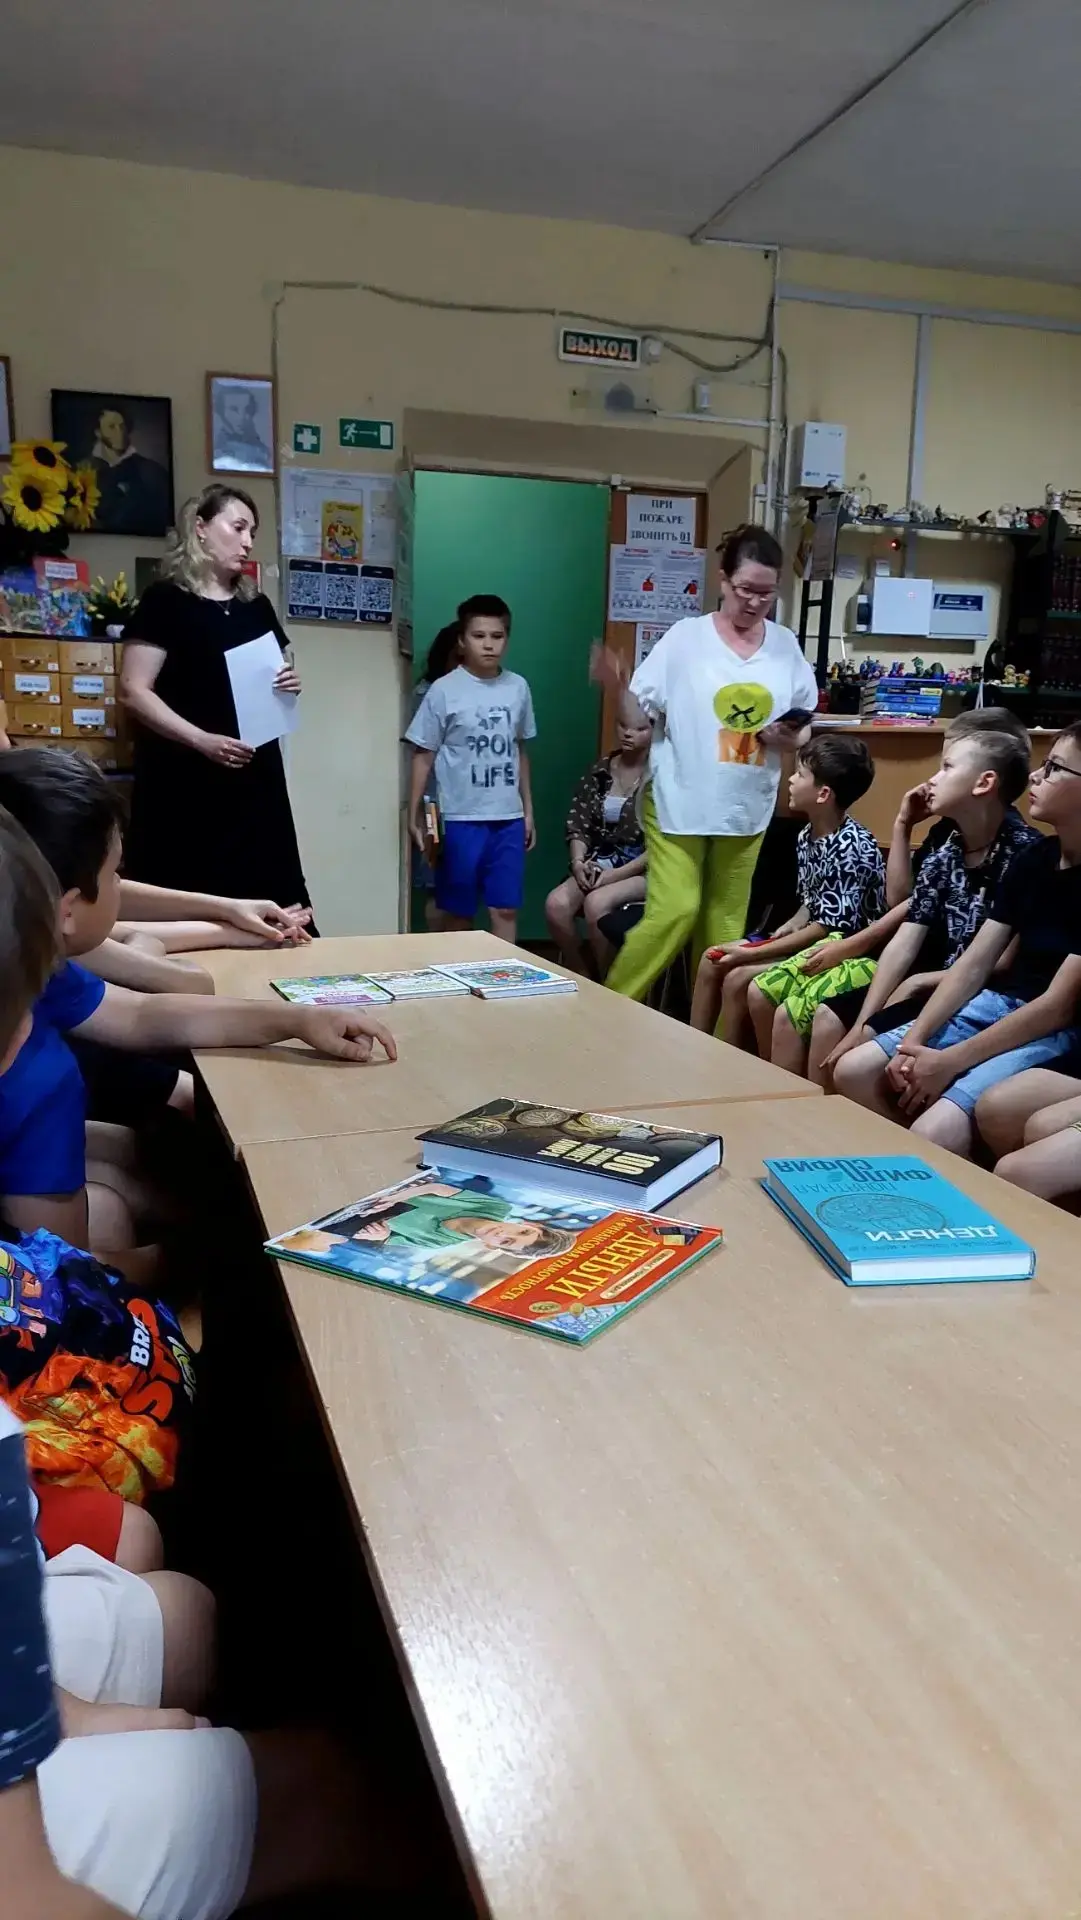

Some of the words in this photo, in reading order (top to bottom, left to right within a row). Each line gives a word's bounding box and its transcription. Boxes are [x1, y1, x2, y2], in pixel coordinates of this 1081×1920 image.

[566, 334, 633, 361] ВЫХОД
[651, 499, 673, 509] ПРИ
[639, 513, 684, 525] ПОЖАРЕ
[471, 762, 515, 788] LIFE
[602, 1151, 661, 1175] 100
[864, 1224, 999, 1242] ДЕНЬГИ
[544, 1230, 661, 1300] ДЕНЬГИ
[500, 1255, 570, 1301] ГРАМОТНОСТЬ
